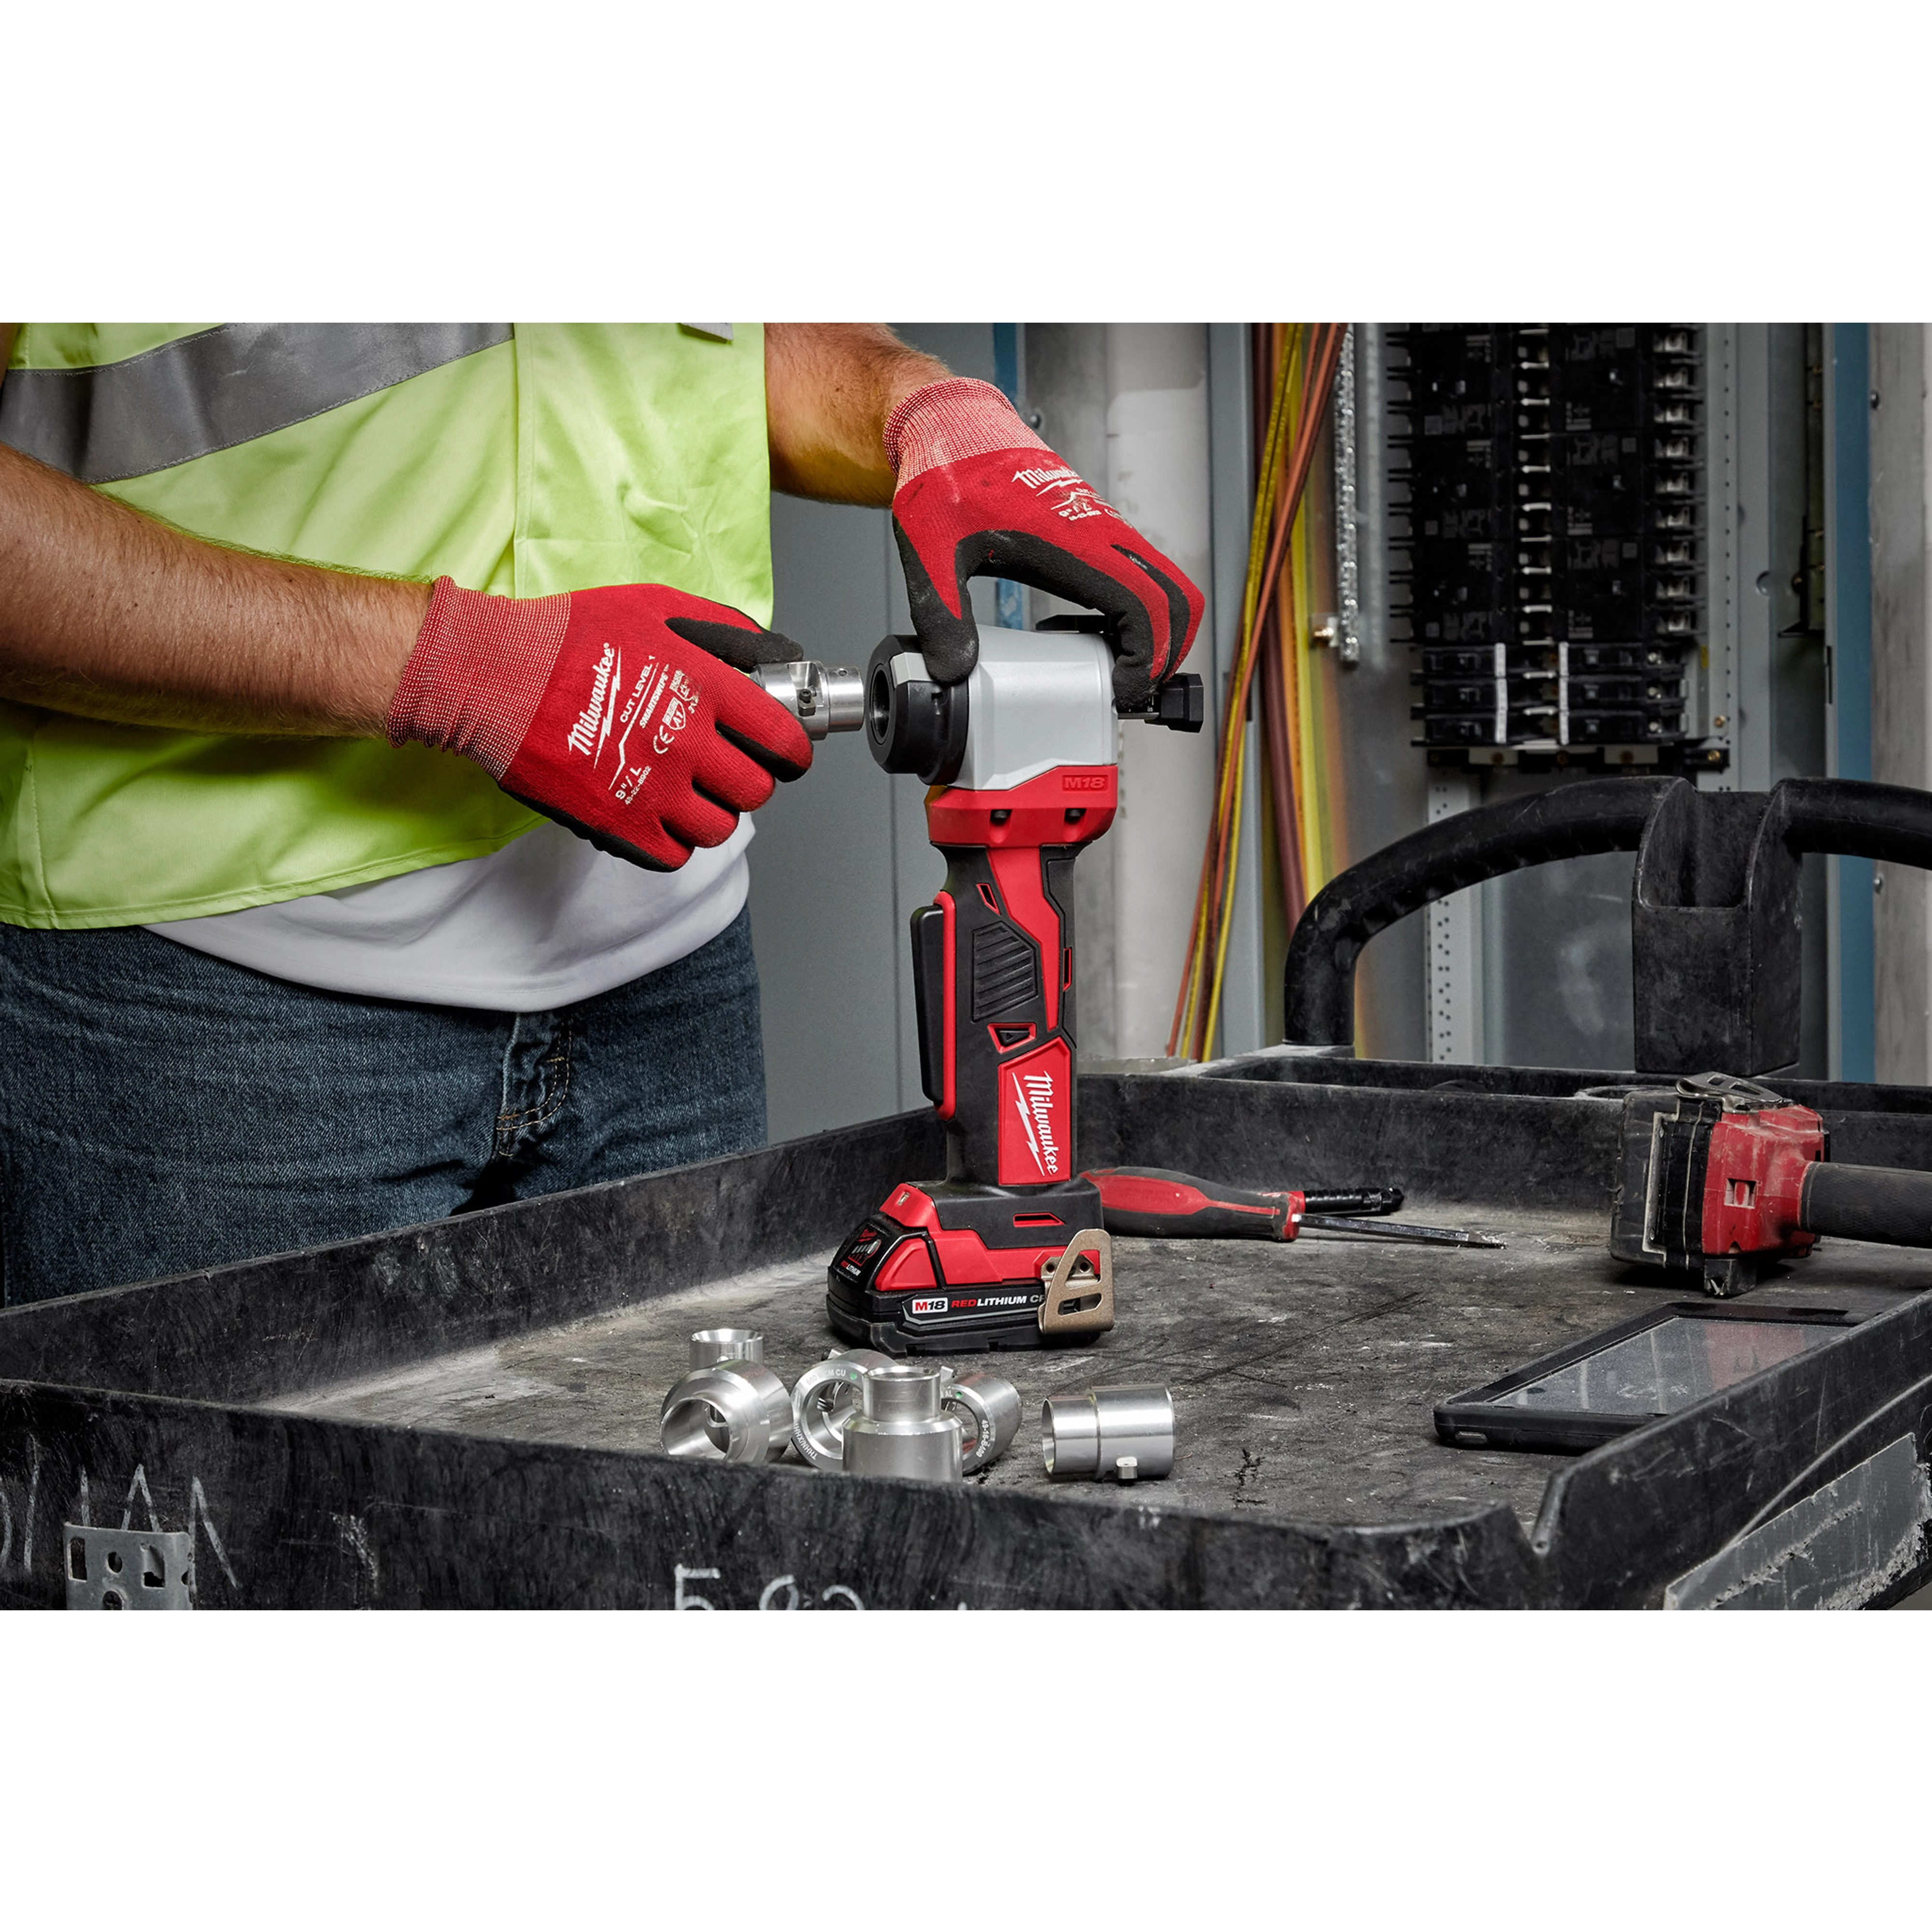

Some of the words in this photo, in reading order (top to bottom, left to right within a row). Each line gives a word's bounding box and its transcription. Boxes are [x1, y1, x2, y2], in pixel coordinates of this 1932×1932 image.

[620, 699, 636, 723] CUT
[632, 664, 653, 698] LEVEL
[629, 767, 642, 777] L
[1065, 777, 1105, 789] M18
[1023, 1070, 1060, 1176] Milwaukee
[915, 1300, 945, 1311] M18
[951, 1295, 1027, 1308] REDLITHIUM
[835, 1368, 846, 1377] CU
